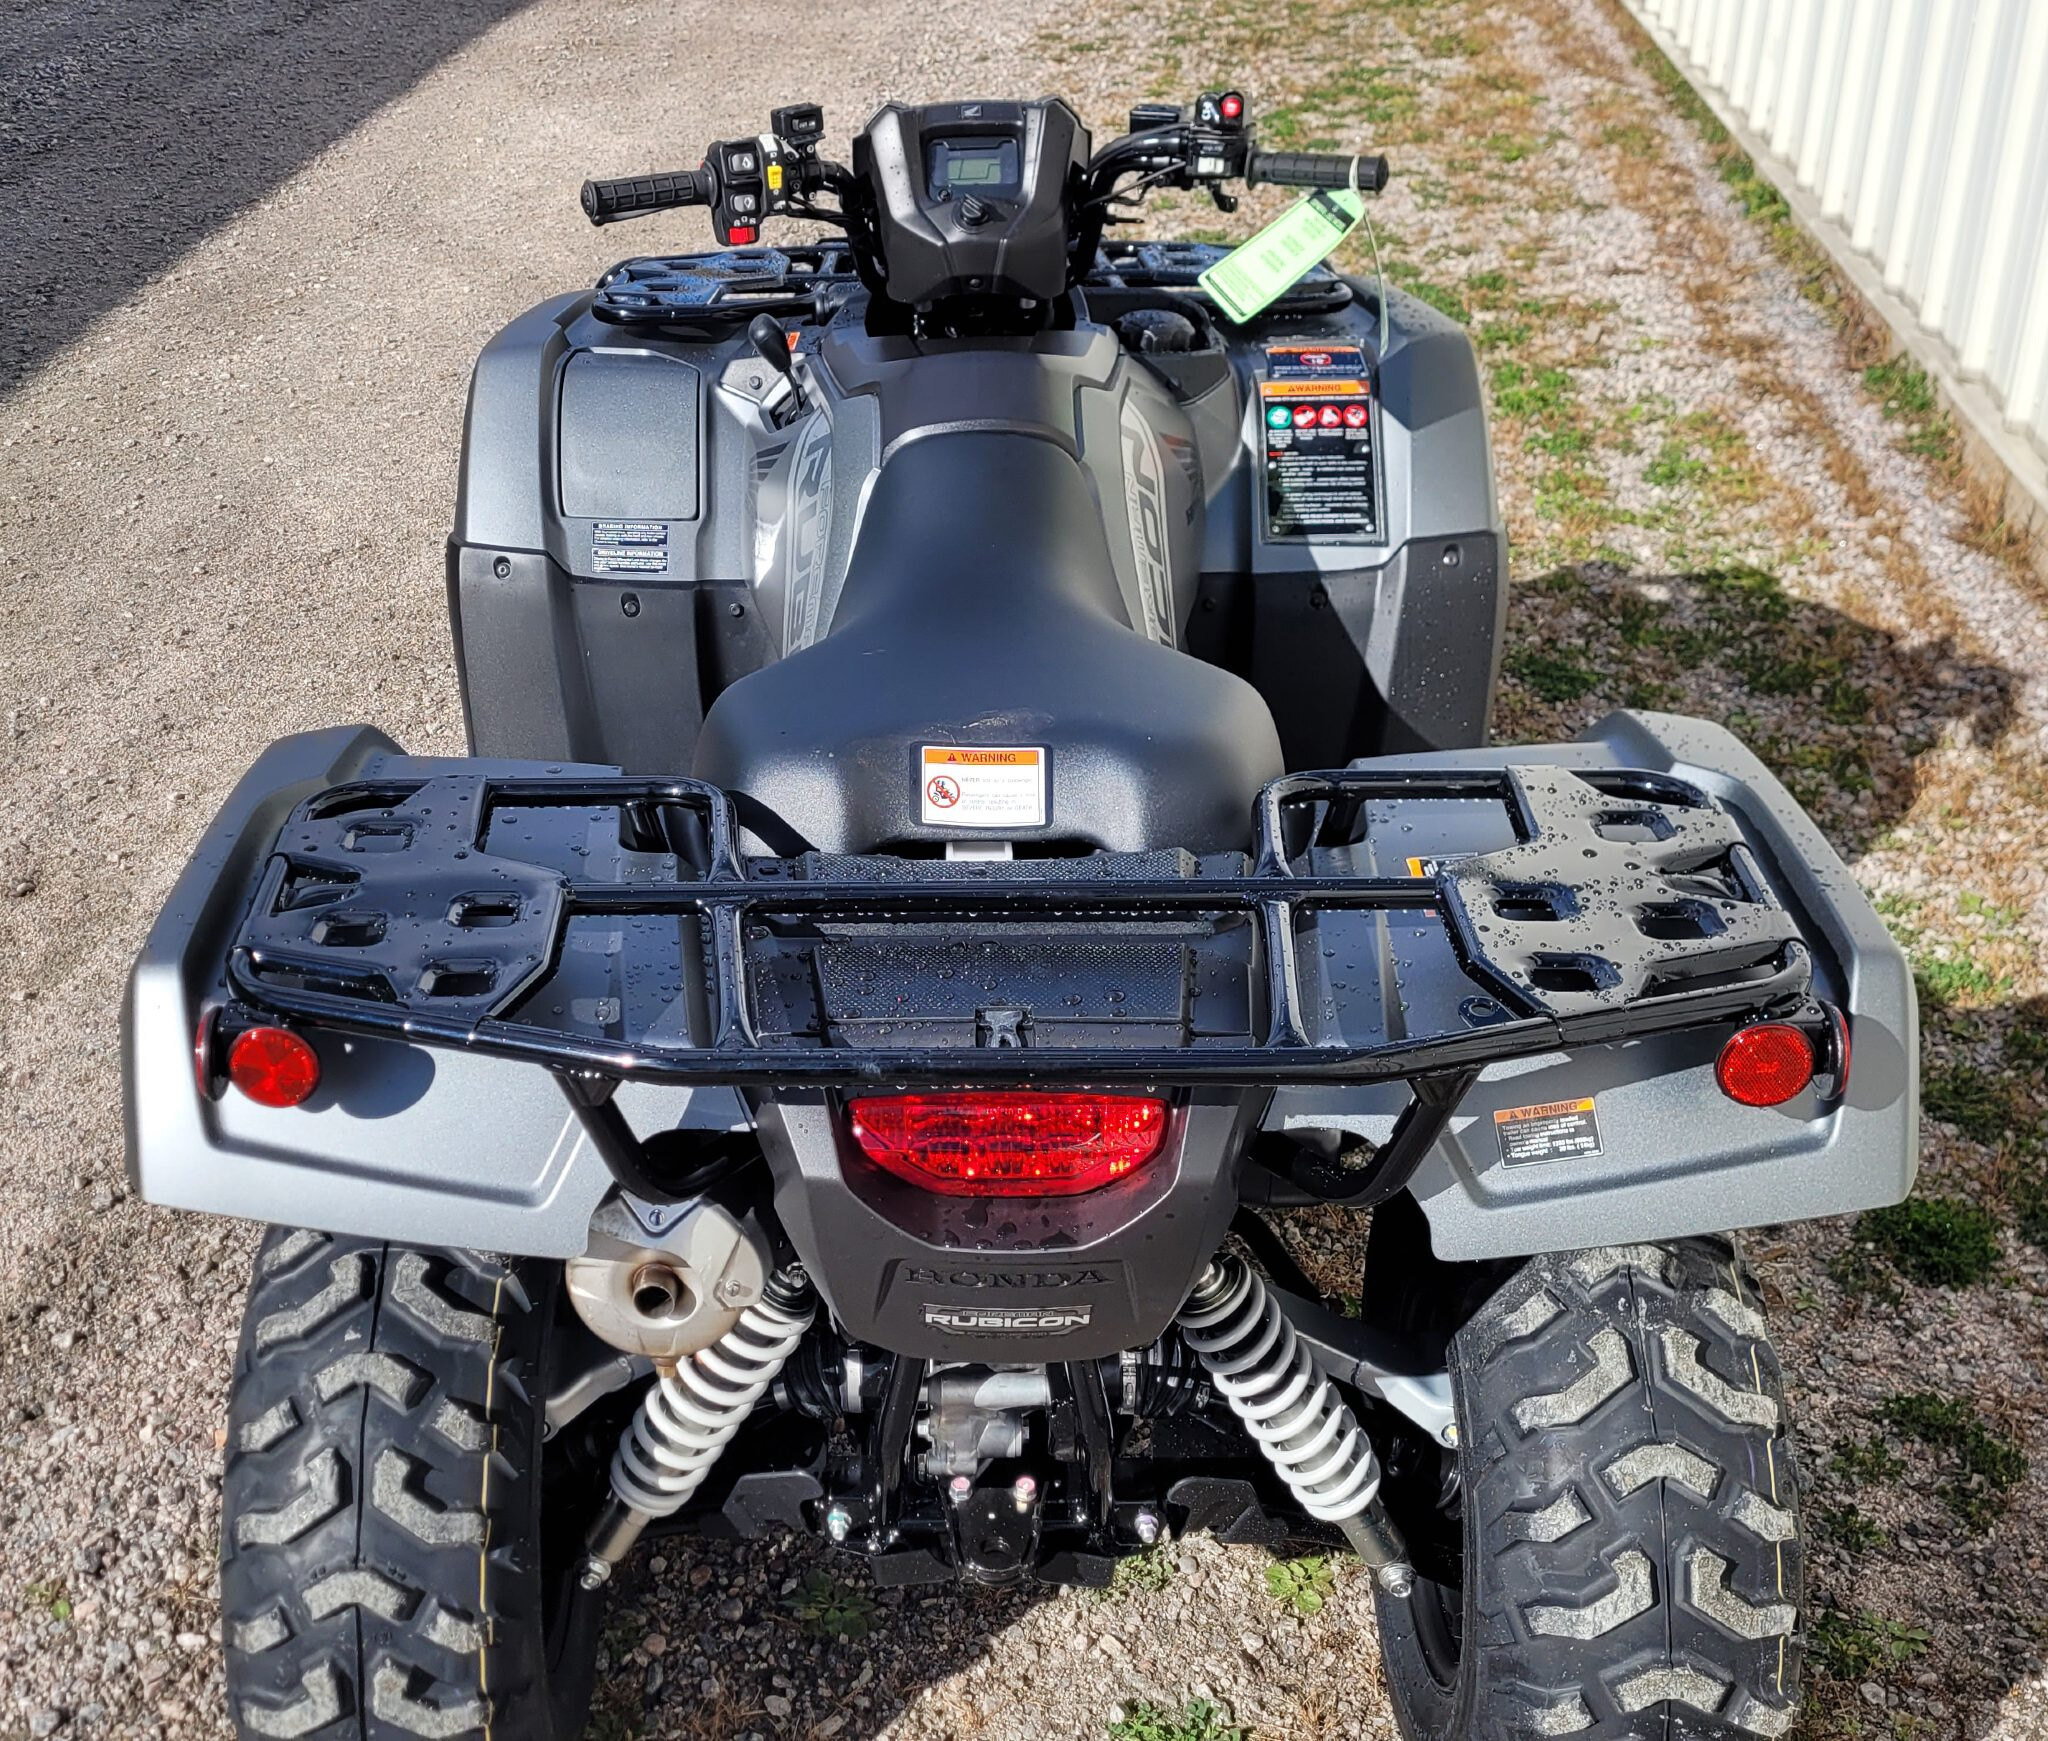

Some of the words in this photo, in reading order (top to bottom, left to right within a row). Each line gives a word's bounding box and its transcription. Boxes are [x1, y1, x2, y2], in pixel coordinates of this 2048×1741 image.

[1296, 384, 1341, 392] WARNING
[961, 753, 1016, 763] WARNING
[1520, 1101, 1577, 1117] WARNING
[905, 1267, 1114, 1288] HONDA
[925, 1313, 1091, 1327] RUBICON
